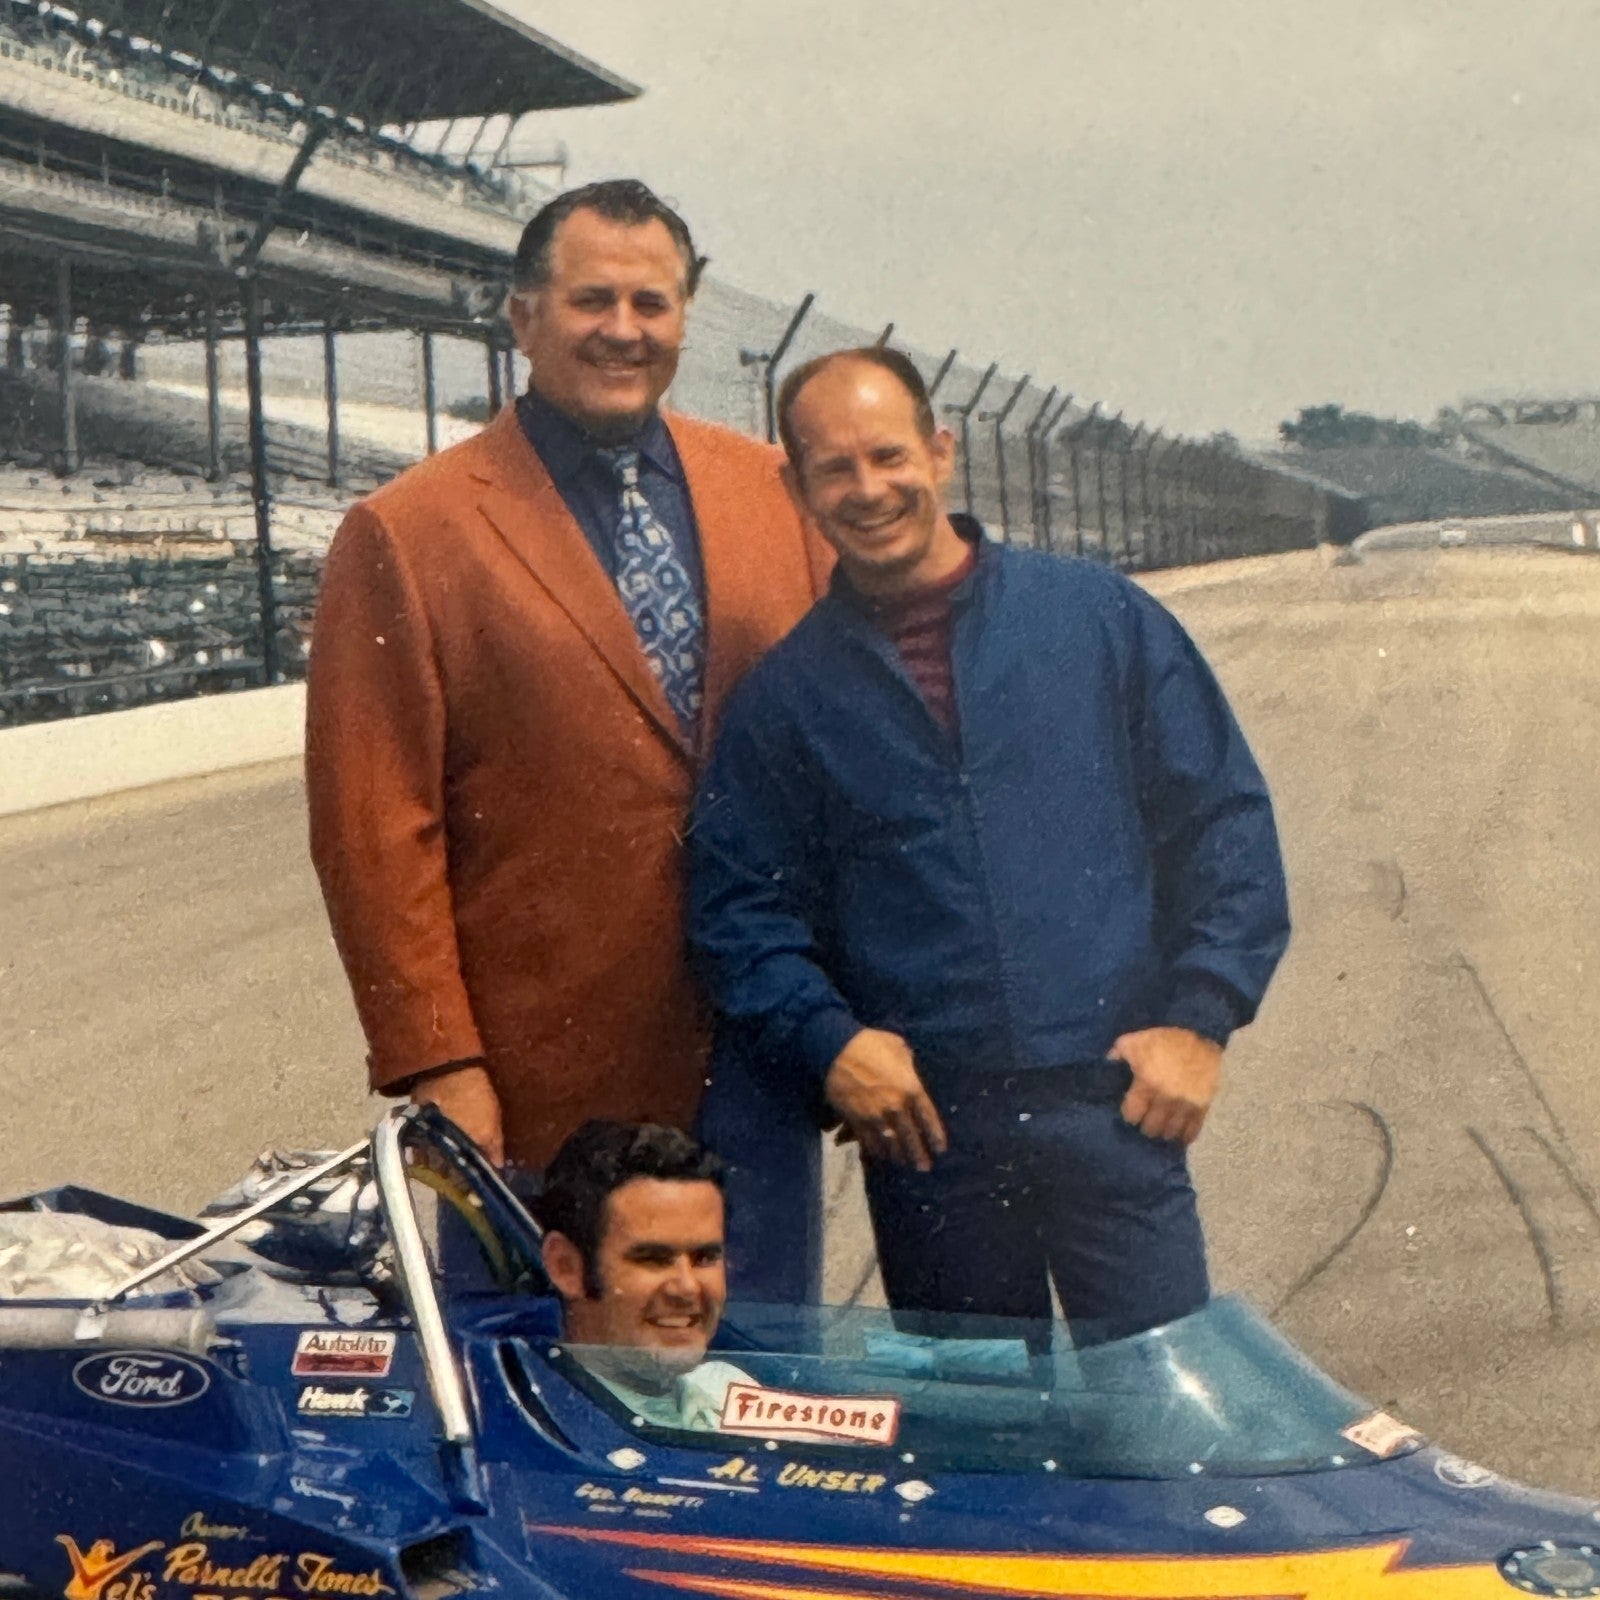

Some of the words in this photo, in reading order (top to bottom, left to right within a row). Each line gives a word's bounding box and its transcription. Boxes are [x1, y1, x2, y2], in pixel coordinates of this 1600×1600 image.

[100, 1357, 184, 1397] Ford
[298, 1386, 370, 1411] Hawk
[735, 1393, 886, 1430] Firestone
[776, 1462, 887, 1494] UNSER
[292, 1552, 396, 1597] Jones
